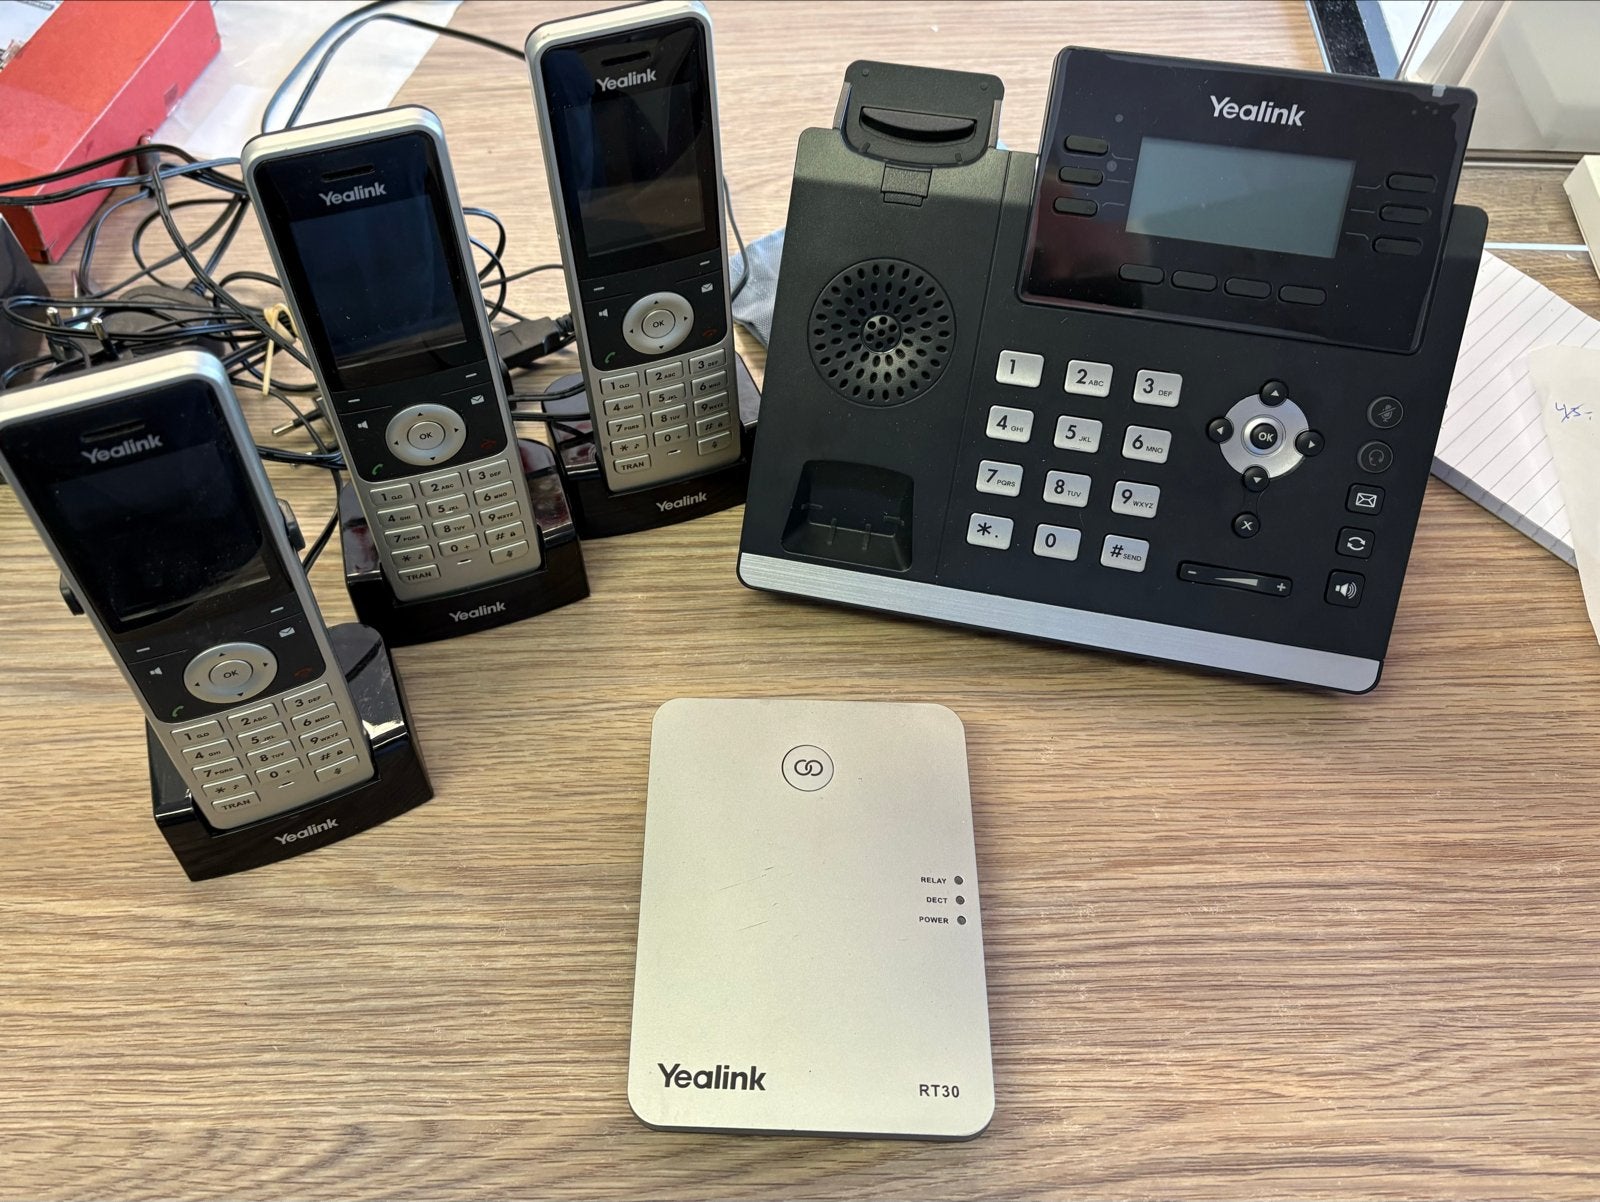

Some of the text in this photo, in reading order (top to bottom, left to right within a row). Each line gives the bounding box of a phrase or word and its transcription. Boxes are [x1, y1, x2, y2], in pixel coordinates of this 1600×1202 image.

[596, 68, 657, 92] Yealink
[1210, 95, 1306, 126] Yealink
[319, 182, 387, 206] Yealink
[652, 320, 664, 328] OK
[698, 360, 705, 369] 3
[1009, 359, 1016, 375] 1
[655, 372, 663, 380] 2
[1075, 369, 1104, 387] 2 ABC
[610, 382, 616, 390] 1
[699, 382, 707, 390] 6
[1142, 377, 1173, 397] 3 DEF
[658, 394, 665, 402] 5
[613, 403, 621, 411] 4
[701, 403, 708, 412] 9
[661, 414, 667, 422] 8
[615, 424, 623, 432] 7
[996, 415, 1024, 433] 4 GHI
[664, 434, 671, 442] 0
[1065, 425, 1092, 443] 5 JKL
[1258, 432, 1274, 442] OK
[1132, 434, 1163, 454] 6 MNO
[80, 434, 163, 464] Yealink
[620, 461, 645, 471] TRAN
[478, 471, 487, 480] 3
[987, 468, 1016, 488] 7 PQRS
[430, 483, 440, 492] 2
[1054, 479, 1065, 495] 8
[381, 493, 387, 501] 1
[483, 492, 491, 501] 6
[1121, 489, 1154, 510] 9 WXYZ
[655, 492, 707, 512] Yealink
[437, 504, 445, 513] 5
[387, 514, 396, 522] 4
[488, 513, 496, 522] 9
[443, 524, 451, 533] 8
[394, 535, 402, 543] 7
[1045, 532, 1057, 548] 0
[450, 544, 458, 553] 0
[1110, 544, 1142, 562] # SEND
[406, 571, 432, 581] TRAN
[449, 601, 507, 622] Yealink
[223, 670, 239, 679] OK
[295, 699, 304, 708] 3
[240, 717, 251, 726] 2
[303, 718, 312, 727] 6
[184, 733, 191, 741] 1
[251, 736, 260, 745] 5
[310, 736, 319, 744] 9
[195, 751, 204, 760] 4
[259, 754, 268, 762] 8
[203, 769, 213, 777] 7
[269, 771, 279, 779] 0
[221, 798, 251, 811] TRAN
[274, 817, 339, 845] Yealink
[919, 916, 949, 924] POWER
[658, 1063, 766, 1091] Yealink
[919, 1084, 960, 1098] RT30
